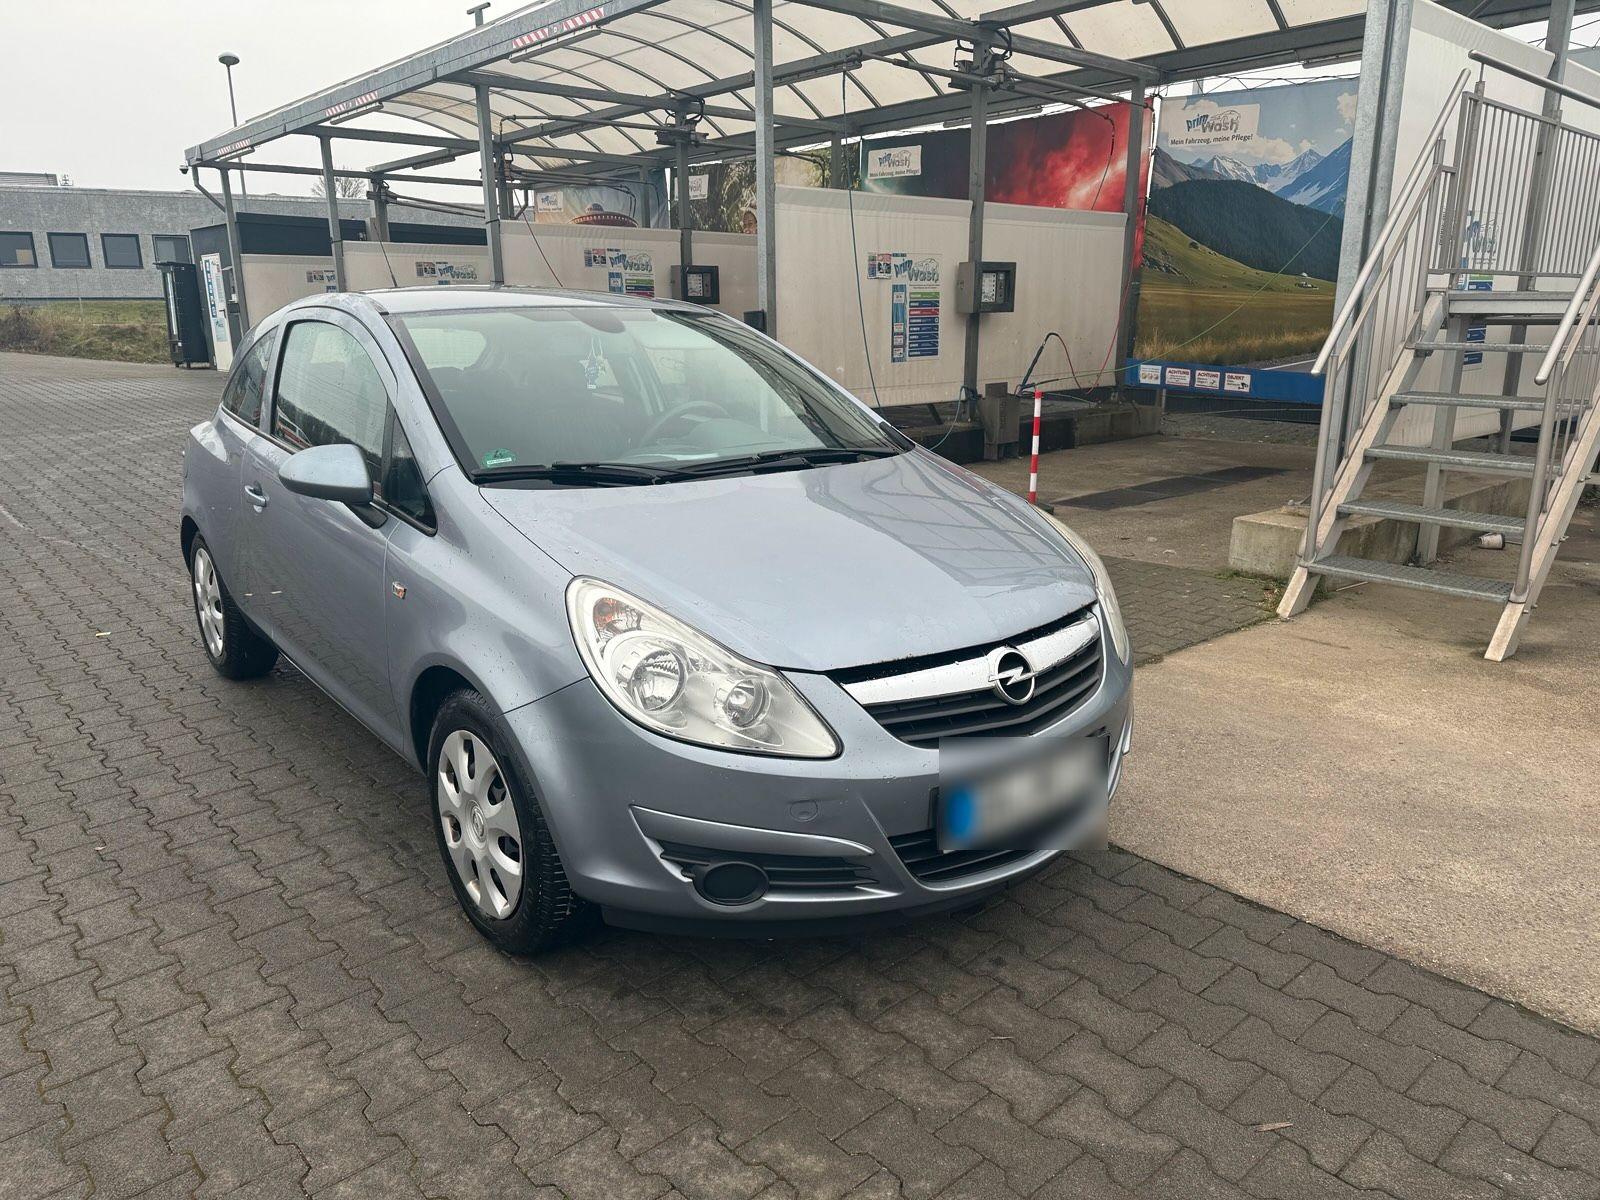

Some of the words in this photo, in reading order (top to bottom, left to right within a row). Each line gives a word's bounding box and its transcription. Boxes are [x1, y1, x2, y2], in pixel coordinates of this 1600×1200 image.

[1185, 137, 1212, 145] Fahrzeug,
[1212, 135, 1230, 143] meine
[1231, 133, 1253, 143] Pflege!
